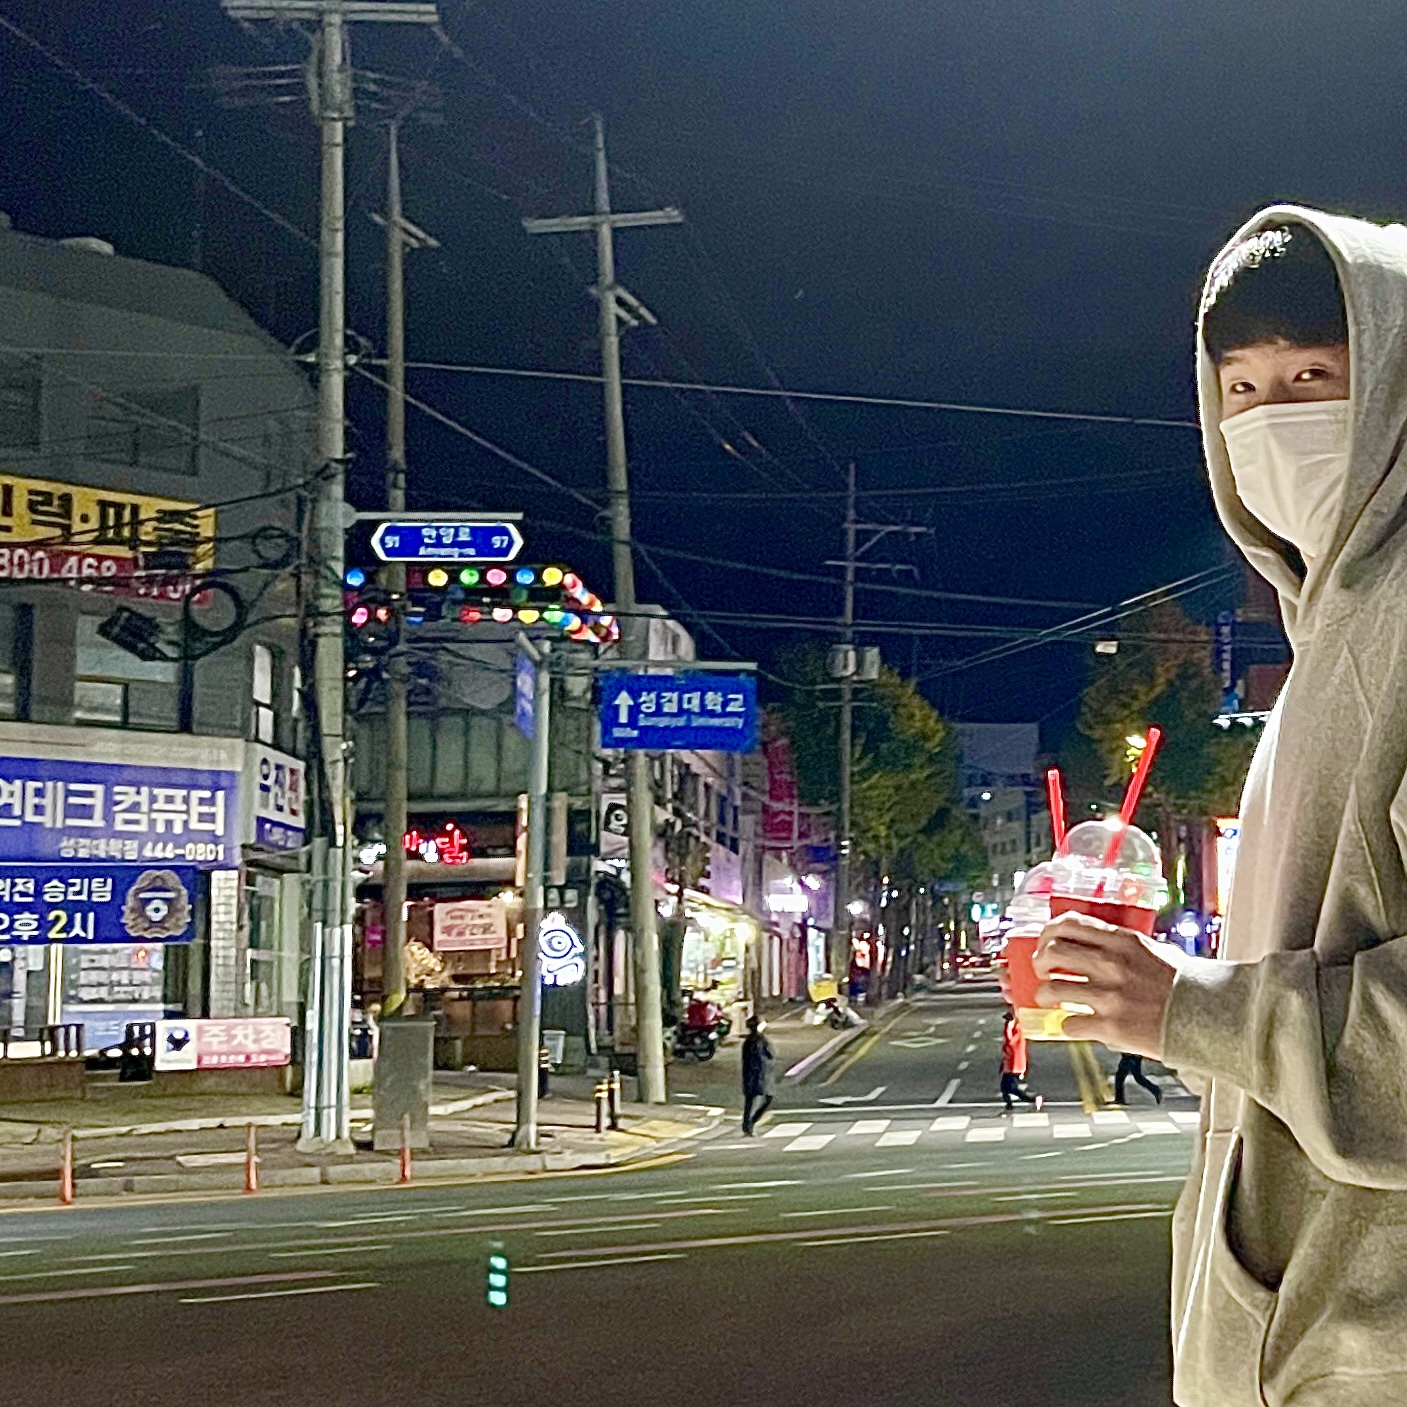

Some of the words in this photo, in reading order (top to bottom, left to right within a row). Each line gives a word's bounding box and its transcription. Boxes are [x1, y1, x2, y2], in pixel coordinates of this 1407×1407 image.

[639, 691, 746, 714] 성결대학교
[113, 785, 225, 836] 컴퓨터
[42, 877, 113, 902] 승리팀
[47, 909, 95, 940] 2시
[201, 1024, 284, 1051] 주차장
